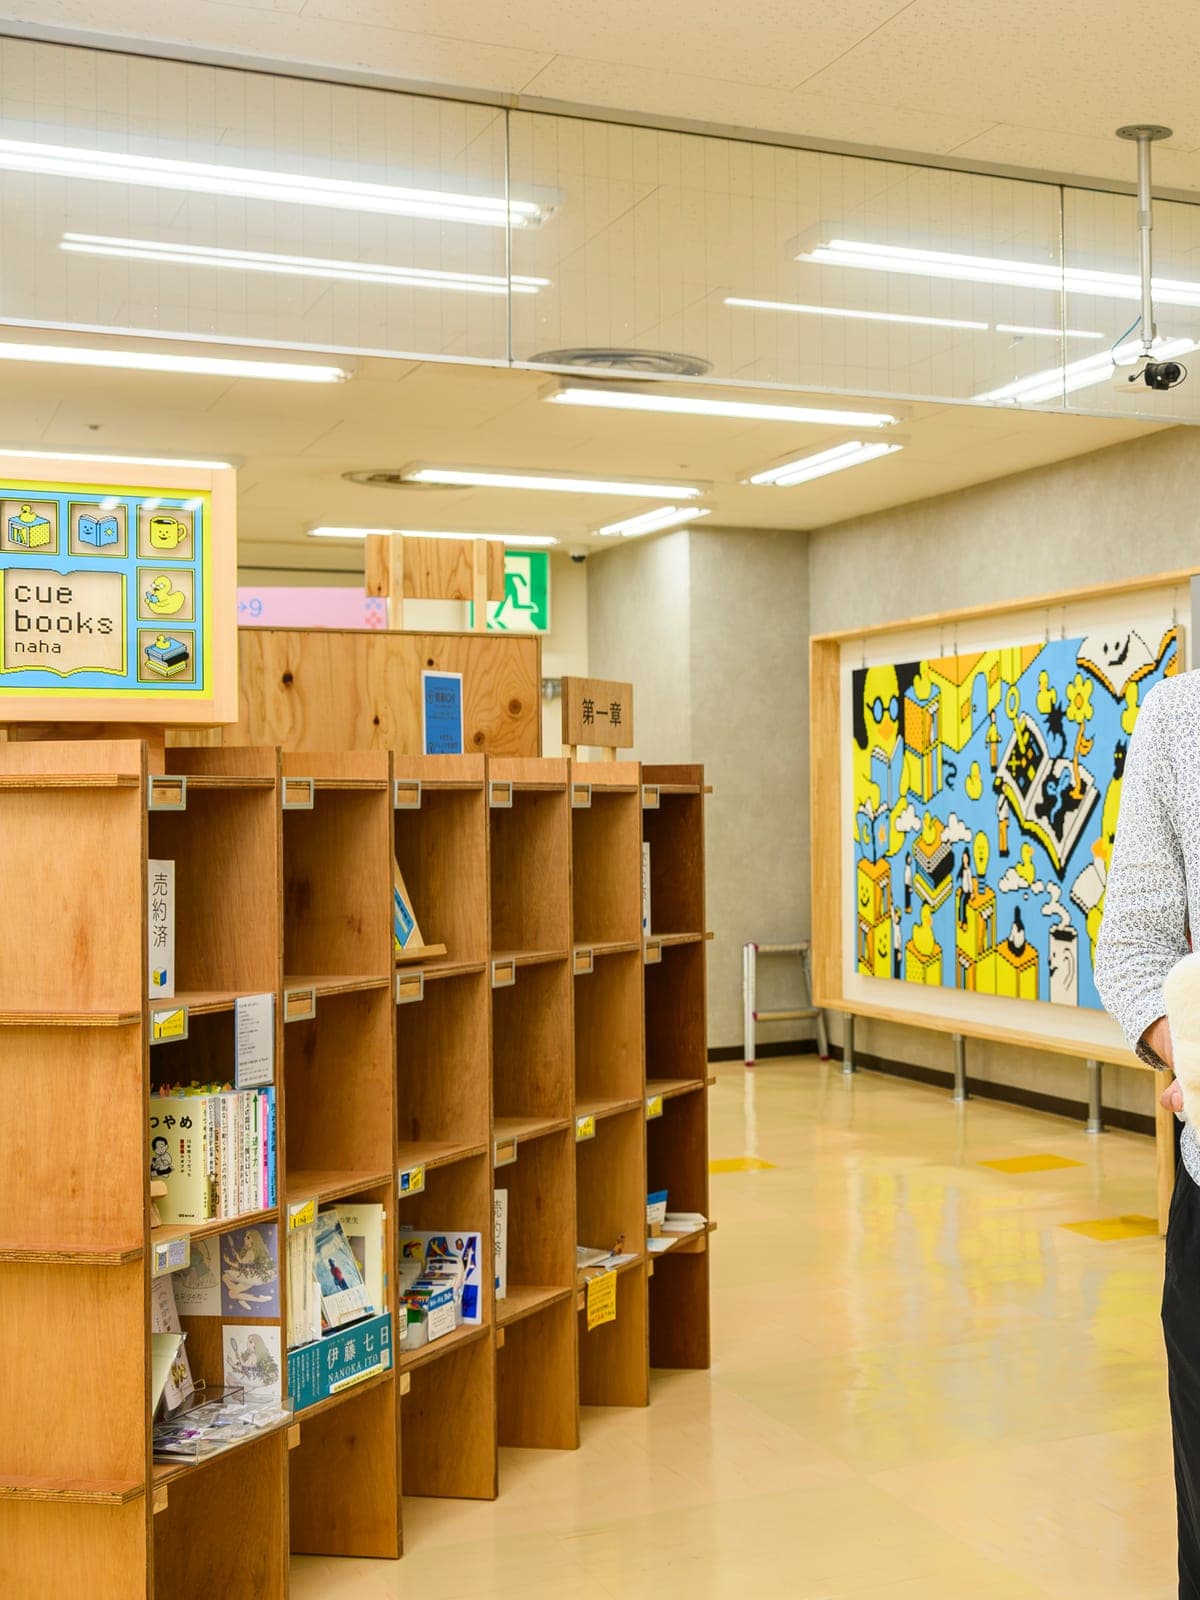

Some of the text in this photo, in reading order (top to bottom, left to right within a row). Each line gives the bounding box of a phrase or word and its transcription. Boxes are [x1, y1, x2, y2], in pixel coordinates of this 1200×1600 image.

[14, 585, 73, 604] cue
[14, 609, 113, 635] books
[14, 640, 62, 654] naha
[582, 698, 622, 728] 第一章
[152, 871, 169, 948] 売約済
[327, 1325, 389, 1370] 伊藤七日
[328, 1353, 379, 1384] NANOKA ITO
